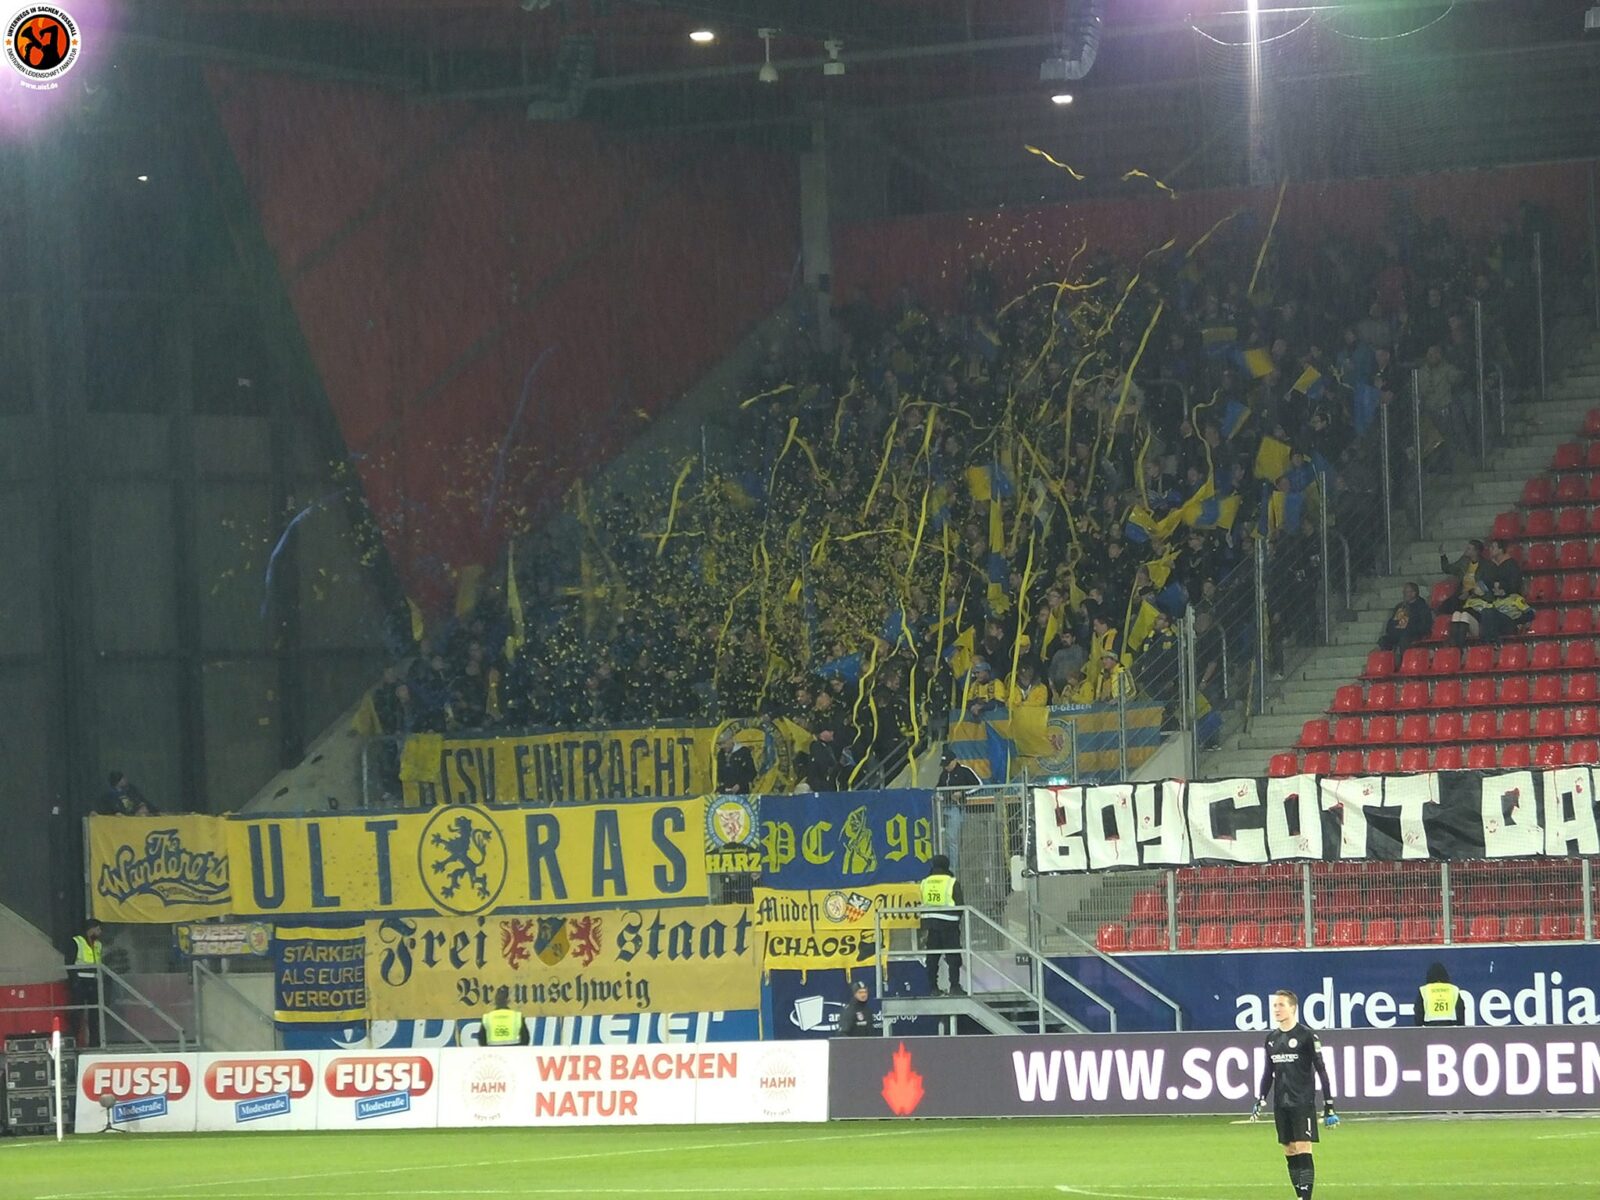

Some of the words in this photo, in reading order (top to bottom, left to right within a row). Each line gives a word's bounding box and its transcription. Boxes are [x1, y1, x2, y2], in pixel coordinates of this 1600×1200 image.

[514, 737, 694, 801] EINTRACHT
[1033, 773, 1441, 872] BOYCOTT
[1482, 766, 1600, 858] QA
[705, 852, 762, 874] HARZ
[927, 892, 941, 902] 378
[283, 941, 364, 963] STÄRKER
[379, 915, 488, 986] Frei
[768, 935, 856, 958] CHAOS
[281, 968, 315, 985] ALS
[318, 965, 364, 983] EURE
[281, 988, 365, 1008] VERBOTE
[457, 971, 651, 1009] Brunschweig
[1434, 1002, 1449, 1012] 261
[335, 1062, 426, 1091] FUSSL
[536, 1055, 602, 1082] WIR
[610, 1052, 738, 1081] BACKEN
[93, 1067, 183, 1096] FUSSL
[215, 1065, 306, 1094] FUSSL
[471, 1081, 506, 1093] HAHN
[760, 1077, 797, 1089] HAHN
[241, 1099, 285, 1114] Modestraße
[361, 1097, 405, 1113] Modestraße
[535, 1090, 638, 1117] NATUR
